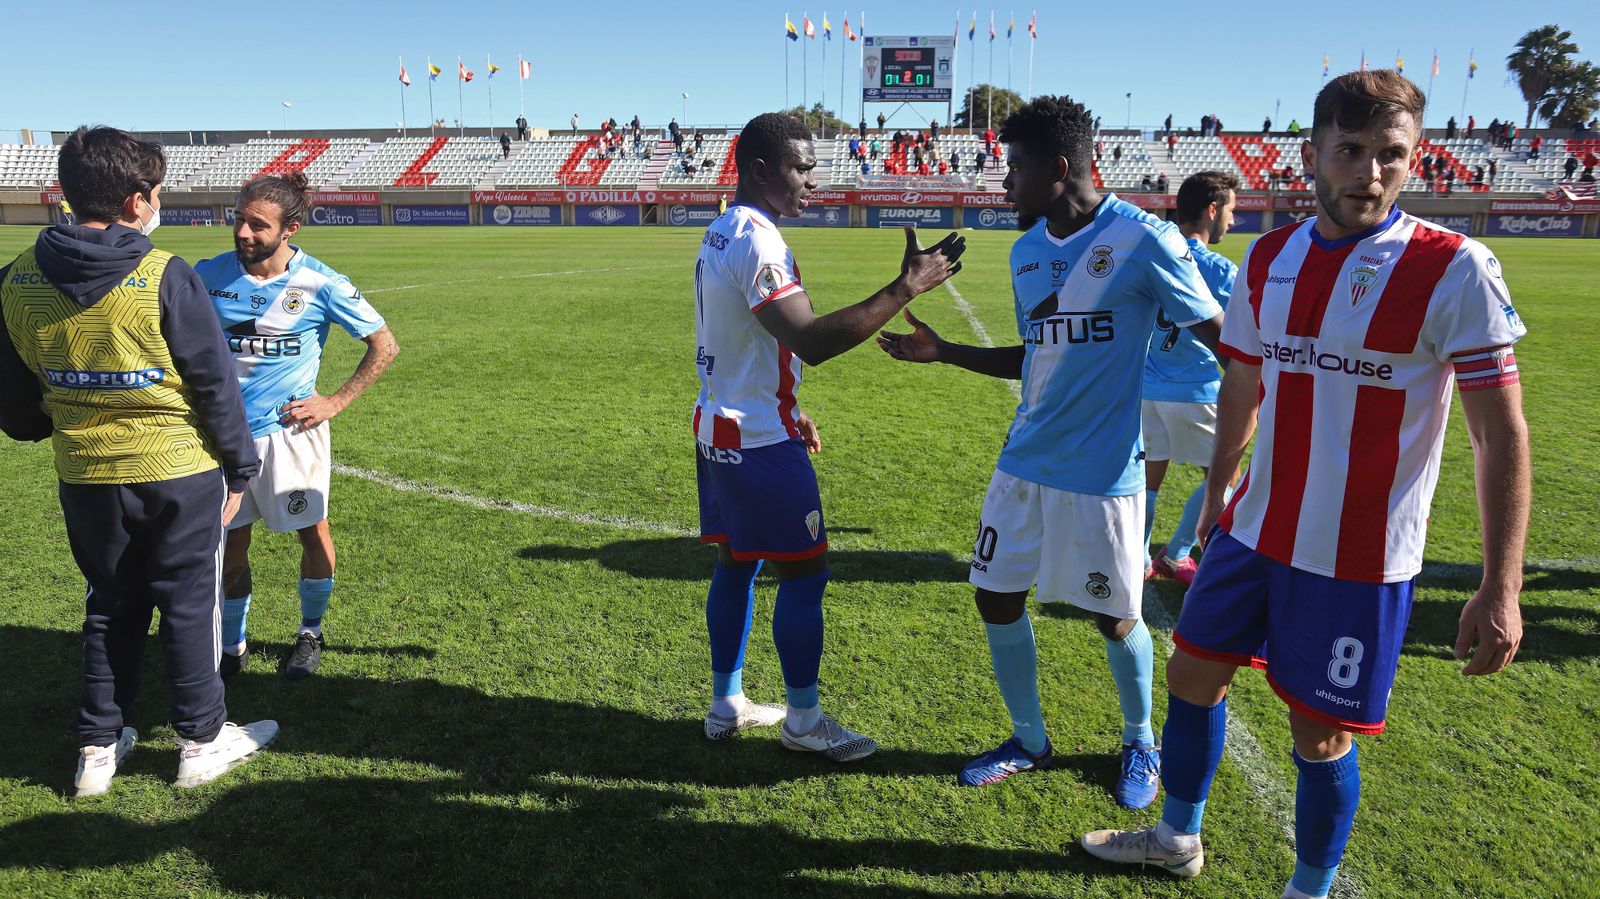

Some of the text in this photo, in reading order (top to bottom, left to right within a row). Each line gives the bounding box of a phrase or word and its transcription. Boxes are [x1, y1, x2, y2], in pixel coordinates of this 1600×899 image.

[885, 74, 899, 85] 01
[903, 70, 912, 82] 2
[916, 74, 930, 85] 01
[580, 191, 642, 202] PADILLA
[963, 194, 1006, 205] maste
[180, 208, 212, 216] FACTORY
[879, 209, 941, 218] EUROPEA
[1498, 216, 1572, 233] KubeClub
[1016, 261, 1040, 276] LEGEA
[209, 288, 240, 300] LEGEA
[228, 335, 302, 357] OTUS
[1260, 340, 1393, 381] ster.house
[971, 560, 988, 574] GEA
[1327, 636, 1365, 689] 8
[1315, 688, 1361, 709] uhlsport
